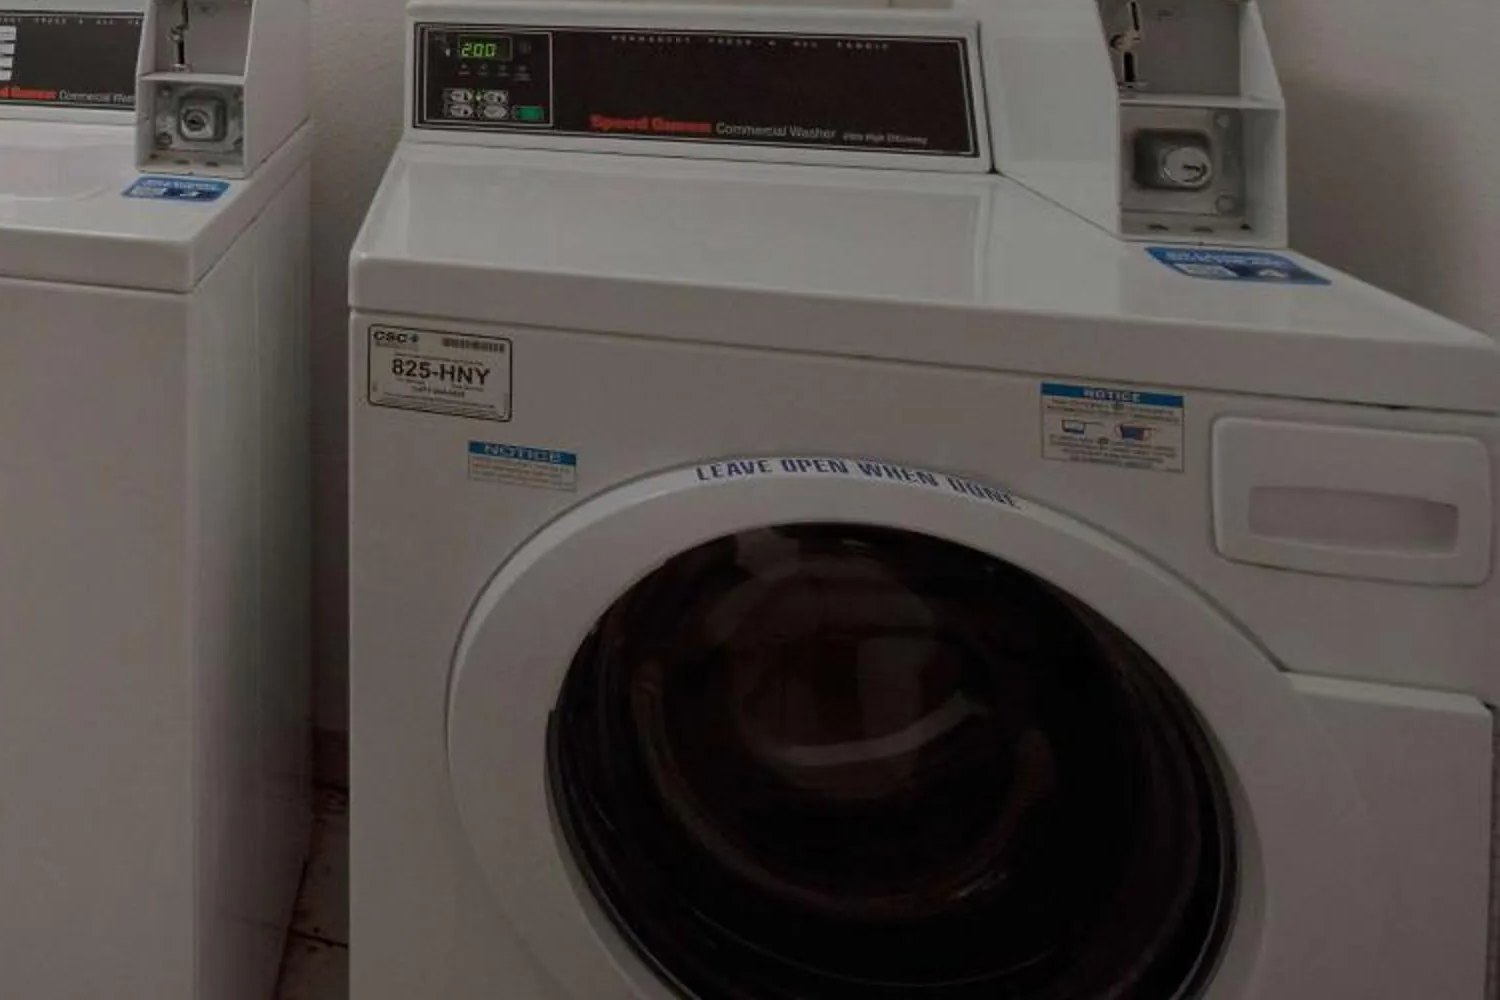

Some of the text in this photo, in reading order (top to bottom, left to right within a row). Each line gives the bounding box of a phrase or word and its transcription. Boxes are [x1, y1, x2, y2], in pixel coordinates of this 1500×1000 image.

[392, 357, 490, 386] 825-HNY
[1084, 388, 1141, 404] NOTICE
[484, 443, 564, 464] NOTICE
[697, 458, 773, 482] LEAVE
[781, 457, 849, 474] OPEN
[859, 461, 938, 487] WHEN
